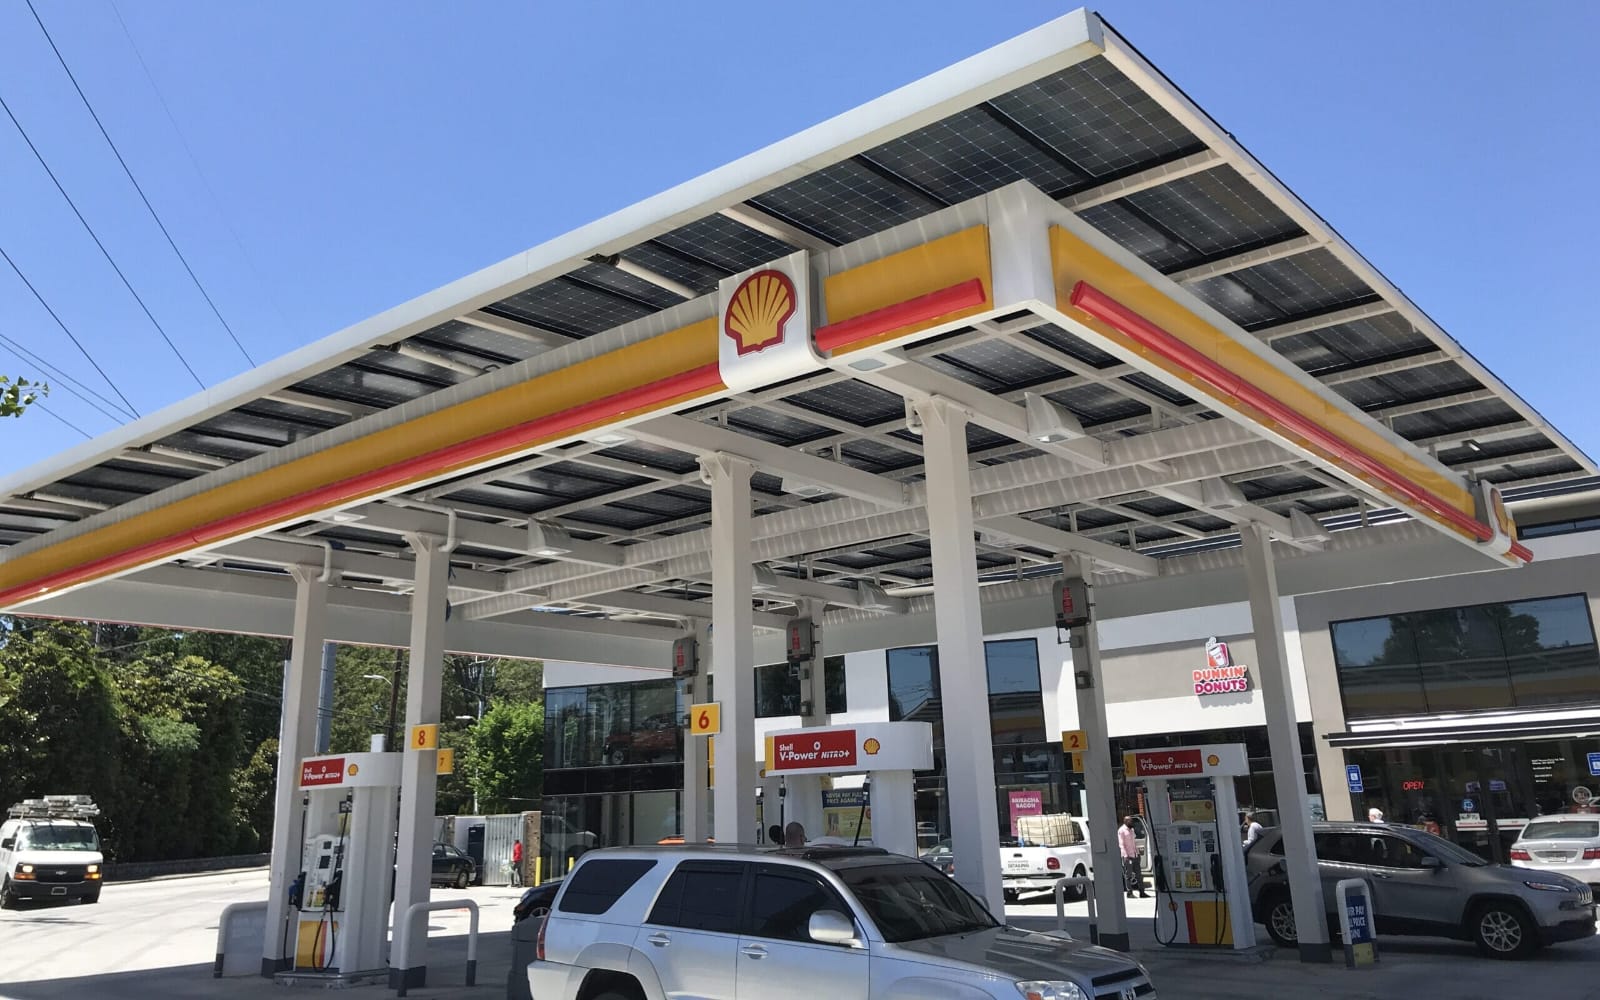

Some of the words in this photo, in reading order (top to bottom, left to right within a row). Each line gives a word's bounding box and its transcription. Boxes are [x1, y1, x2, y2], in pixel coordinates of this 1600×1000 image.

[1193, 665, 1247, 681] DUNKIN'
[1194, 678, 1247, 694] DONUTS
[698, 710, 710, 729] 6
[417, 729, 426, 746] 8
[1070, 734, 1080, 748] 2
[779, 743, 794, 752] Shell
[779, 751, 818, 761] V-Power
[439, 757, 445, 766] 7
[1141, 763, 1172, 771] V-Power
[303, 772, 324, 781] V-Power
[1403, 781, 1424, 790] OPEN
